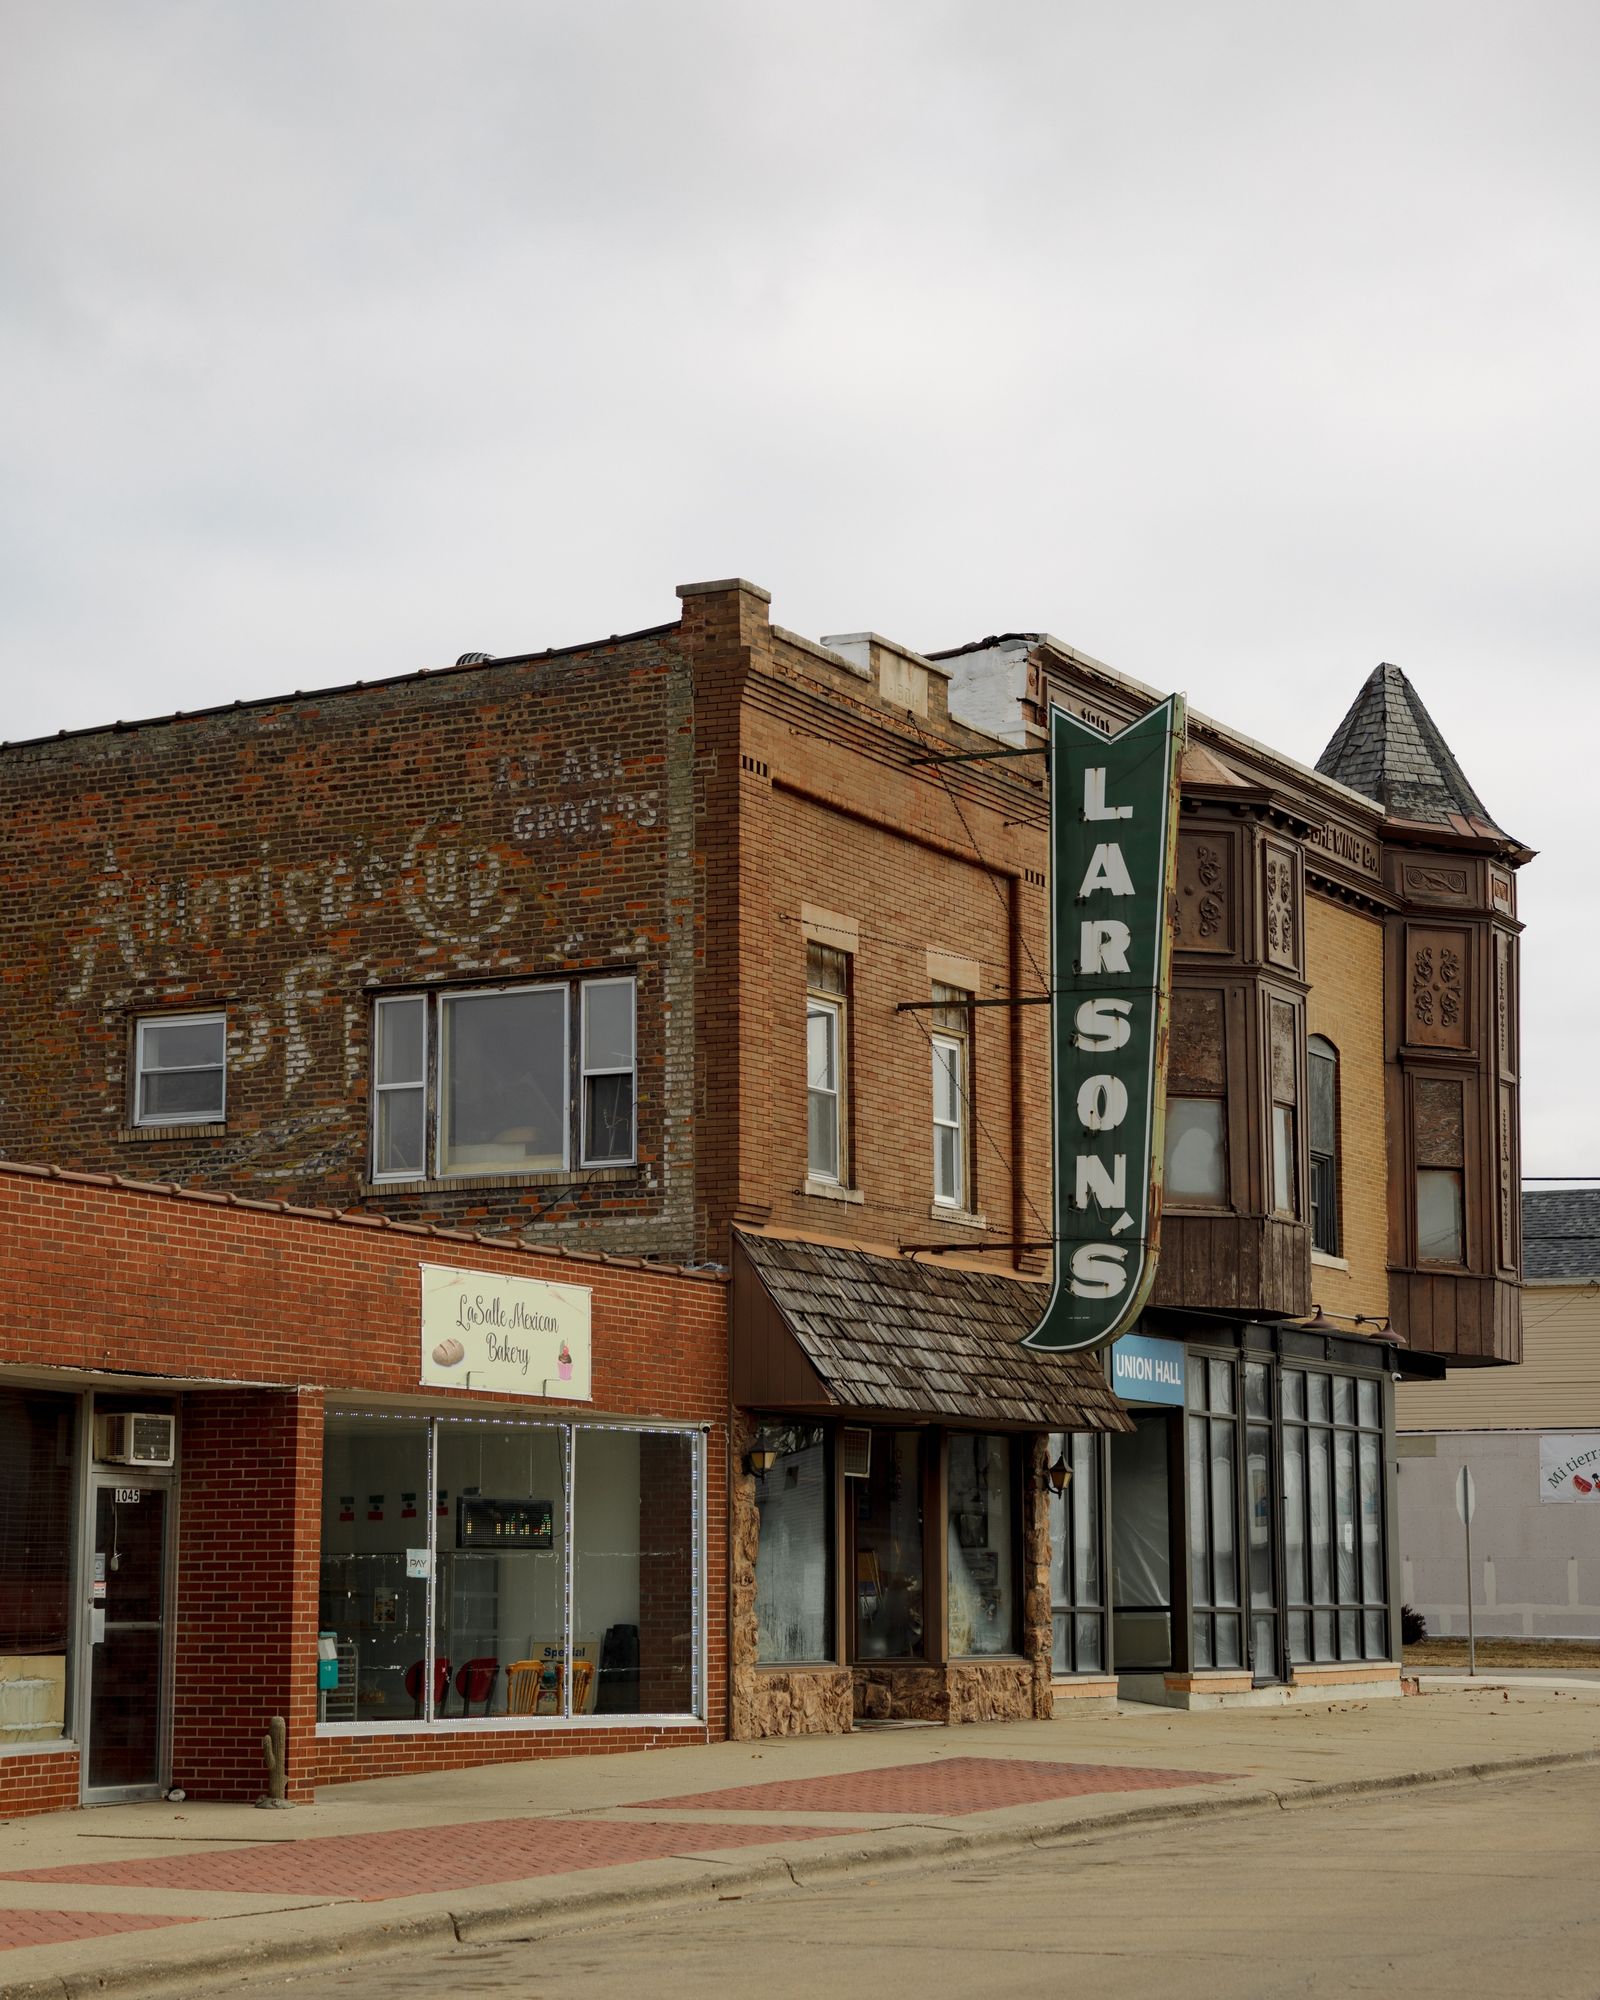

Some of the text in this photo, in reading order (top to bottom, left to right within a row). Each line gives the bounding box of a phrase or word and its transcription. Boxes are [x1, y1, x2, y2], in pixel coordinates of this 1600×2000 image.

[1072, 767, 1136, 1299] LARSON'S
[456, 1294, 559, 1333] LaSalle Mexican
[486, 1332, 530, 1375] Bakery
[1116, 1354, 1181, 1385] UNION HALL
[1547, 1448, 1600, 1488] Mi tierr
[116, 1489, 139, 1502] 1045
[409, 1559, 427, 1568] PAY
[544, 1647, 586, 1659] Speial
